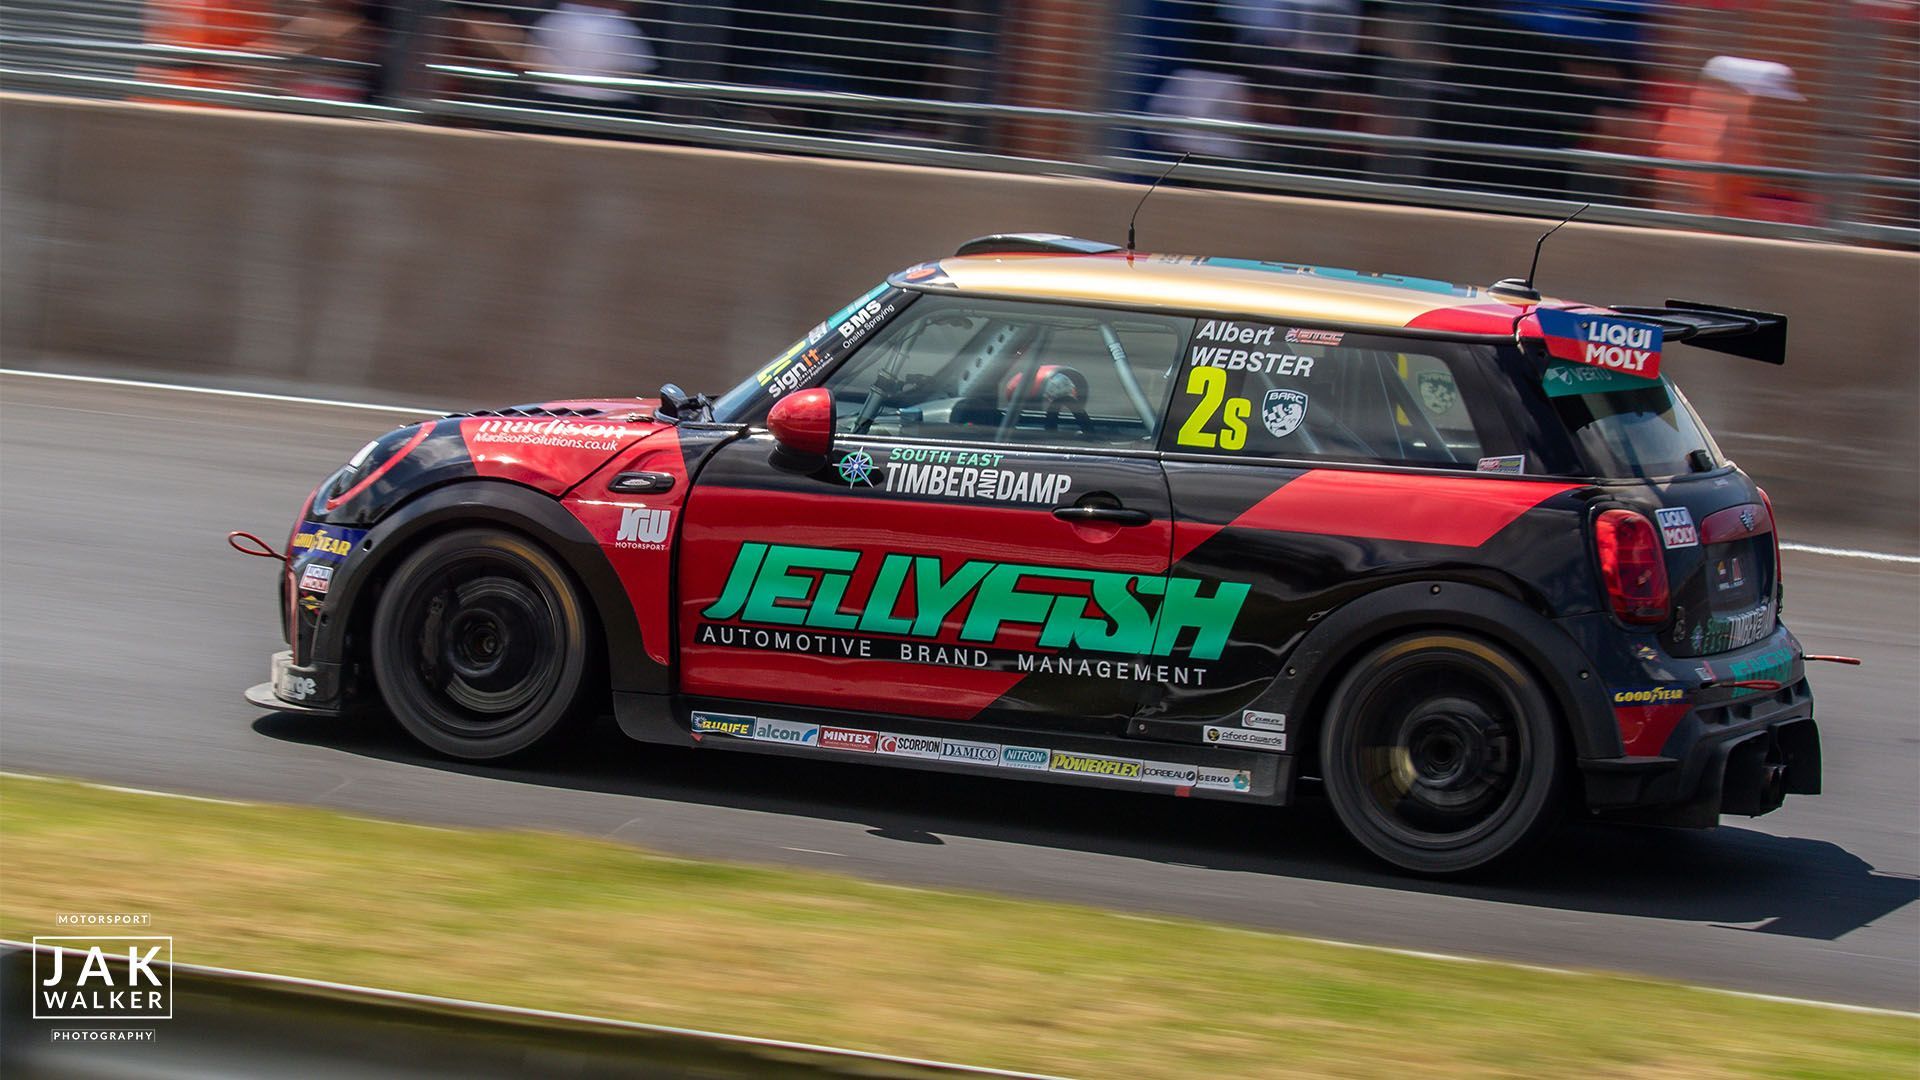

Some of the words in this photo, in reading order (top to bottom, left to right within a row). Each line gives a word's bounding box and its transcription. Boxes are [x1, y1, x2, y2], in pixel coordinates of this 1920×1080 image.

[838, 300, 881, 338] BMS
[843, 329, 865, 348] Onsite
[864, 304, 895, 330] Spraying
[1196, 320, 1275, 346] Albert
[1588, 321, 1653, 349] LIQUI
[1191, 346, 1314, 377] WEBSTER
[1585, 343, 1650, 371] MOLY
[1269, 392, 1304, 404] BARC
[1177, 366, 1251, 450] 2s
[473, 432, 618, 451] MadisonSolutions.co.uk
[889, 447, 950, 464] SOUTH
[957, 452, 1004, 467] EAST
[885, 462, 978, 498] TIMBER
[976, 468, 998, 499] AND
[996, 470, 1072, 504] DAMP
[1659, 510, 1693, 527] LIQUI
[1663, 526, 1697, 545] MOLY
[615, 542, 666, 551] MOTORSPORT
[700, 541, 1252, 661] JELLYFISH
[701, 627, 872, 658] AUTOMOTIVE
[900, 643, 989, 667] BRAND
[1017, 653, 1208, 687] MANAGEMENT
[702, 720, 749, 734] QUAIFE
[757, 724, 800, 741] alcon
[823, 730, 872, 745] MINTEX
[897, 737, 940, 753] SCORPION
[1221, 731, 1248, 741] Aford
[1249, 734, 1282, 745] Awards
[1006, 749, 1043, 761] NITRON
[1051, 753, 1141, 777] POWERFLEX
[1143, 768, 1186, 779] CORBEAU
[1198, 775, 1230, 783] GERKO
